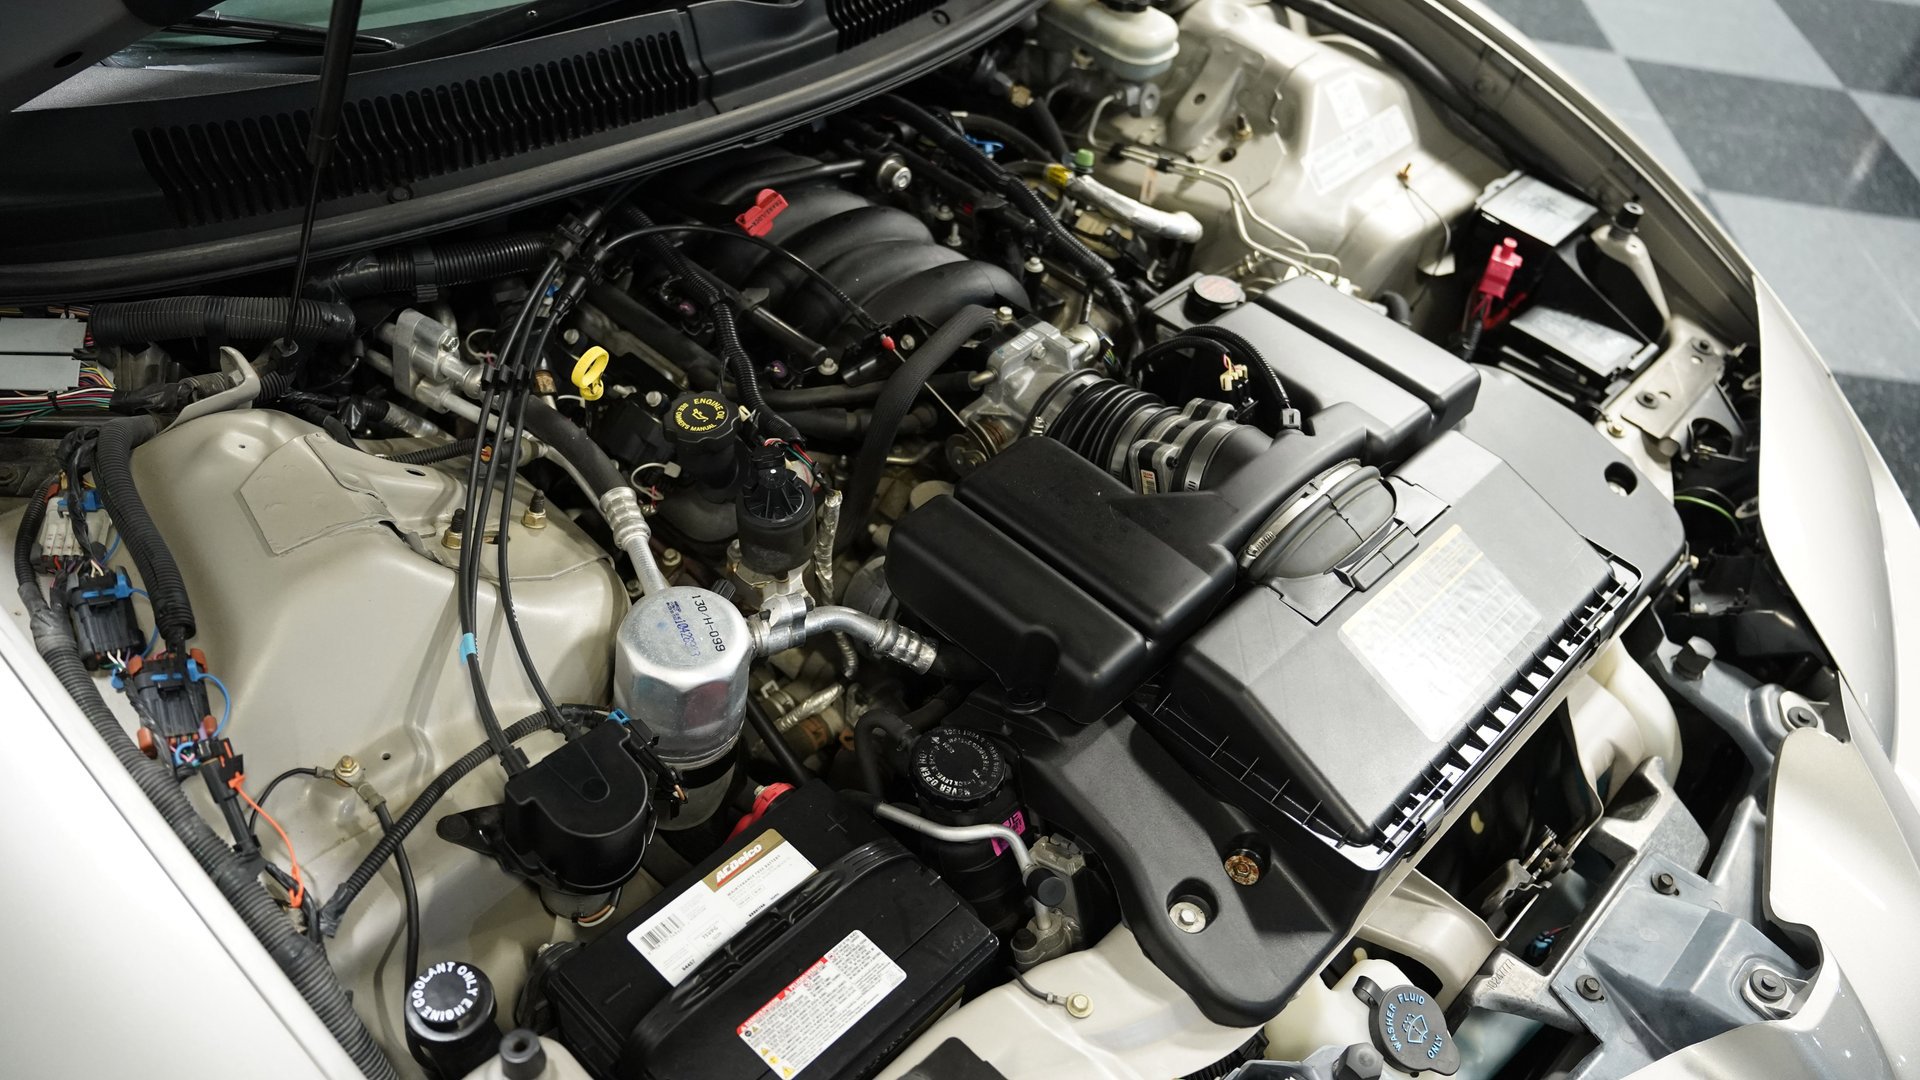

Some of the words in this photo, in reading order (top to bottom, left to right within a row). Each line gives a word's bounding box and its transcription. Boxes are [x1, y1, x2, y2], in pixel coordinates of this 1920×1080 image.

[693, 398, 724, 411] ENGINE
[715, 410, 725, 420] OIL
[689, 423, 718, 432] MANUAL
[692, 594, 726, 653] 130/H-099
[919, 766, 939, 786] OPEN
[714, 843, 763, 883] ACDelco
[411, 961, 456, 1008] COOLANT
[456, 964, 479, 997] ONLY
[420, 997, 474, 1022] ENGINE
[1385, 1002, 1402, 1052] WASHER
[1397, 992, 1425, 1005] FLUID
[1427, 1034, 1443, 1059] ONLY
